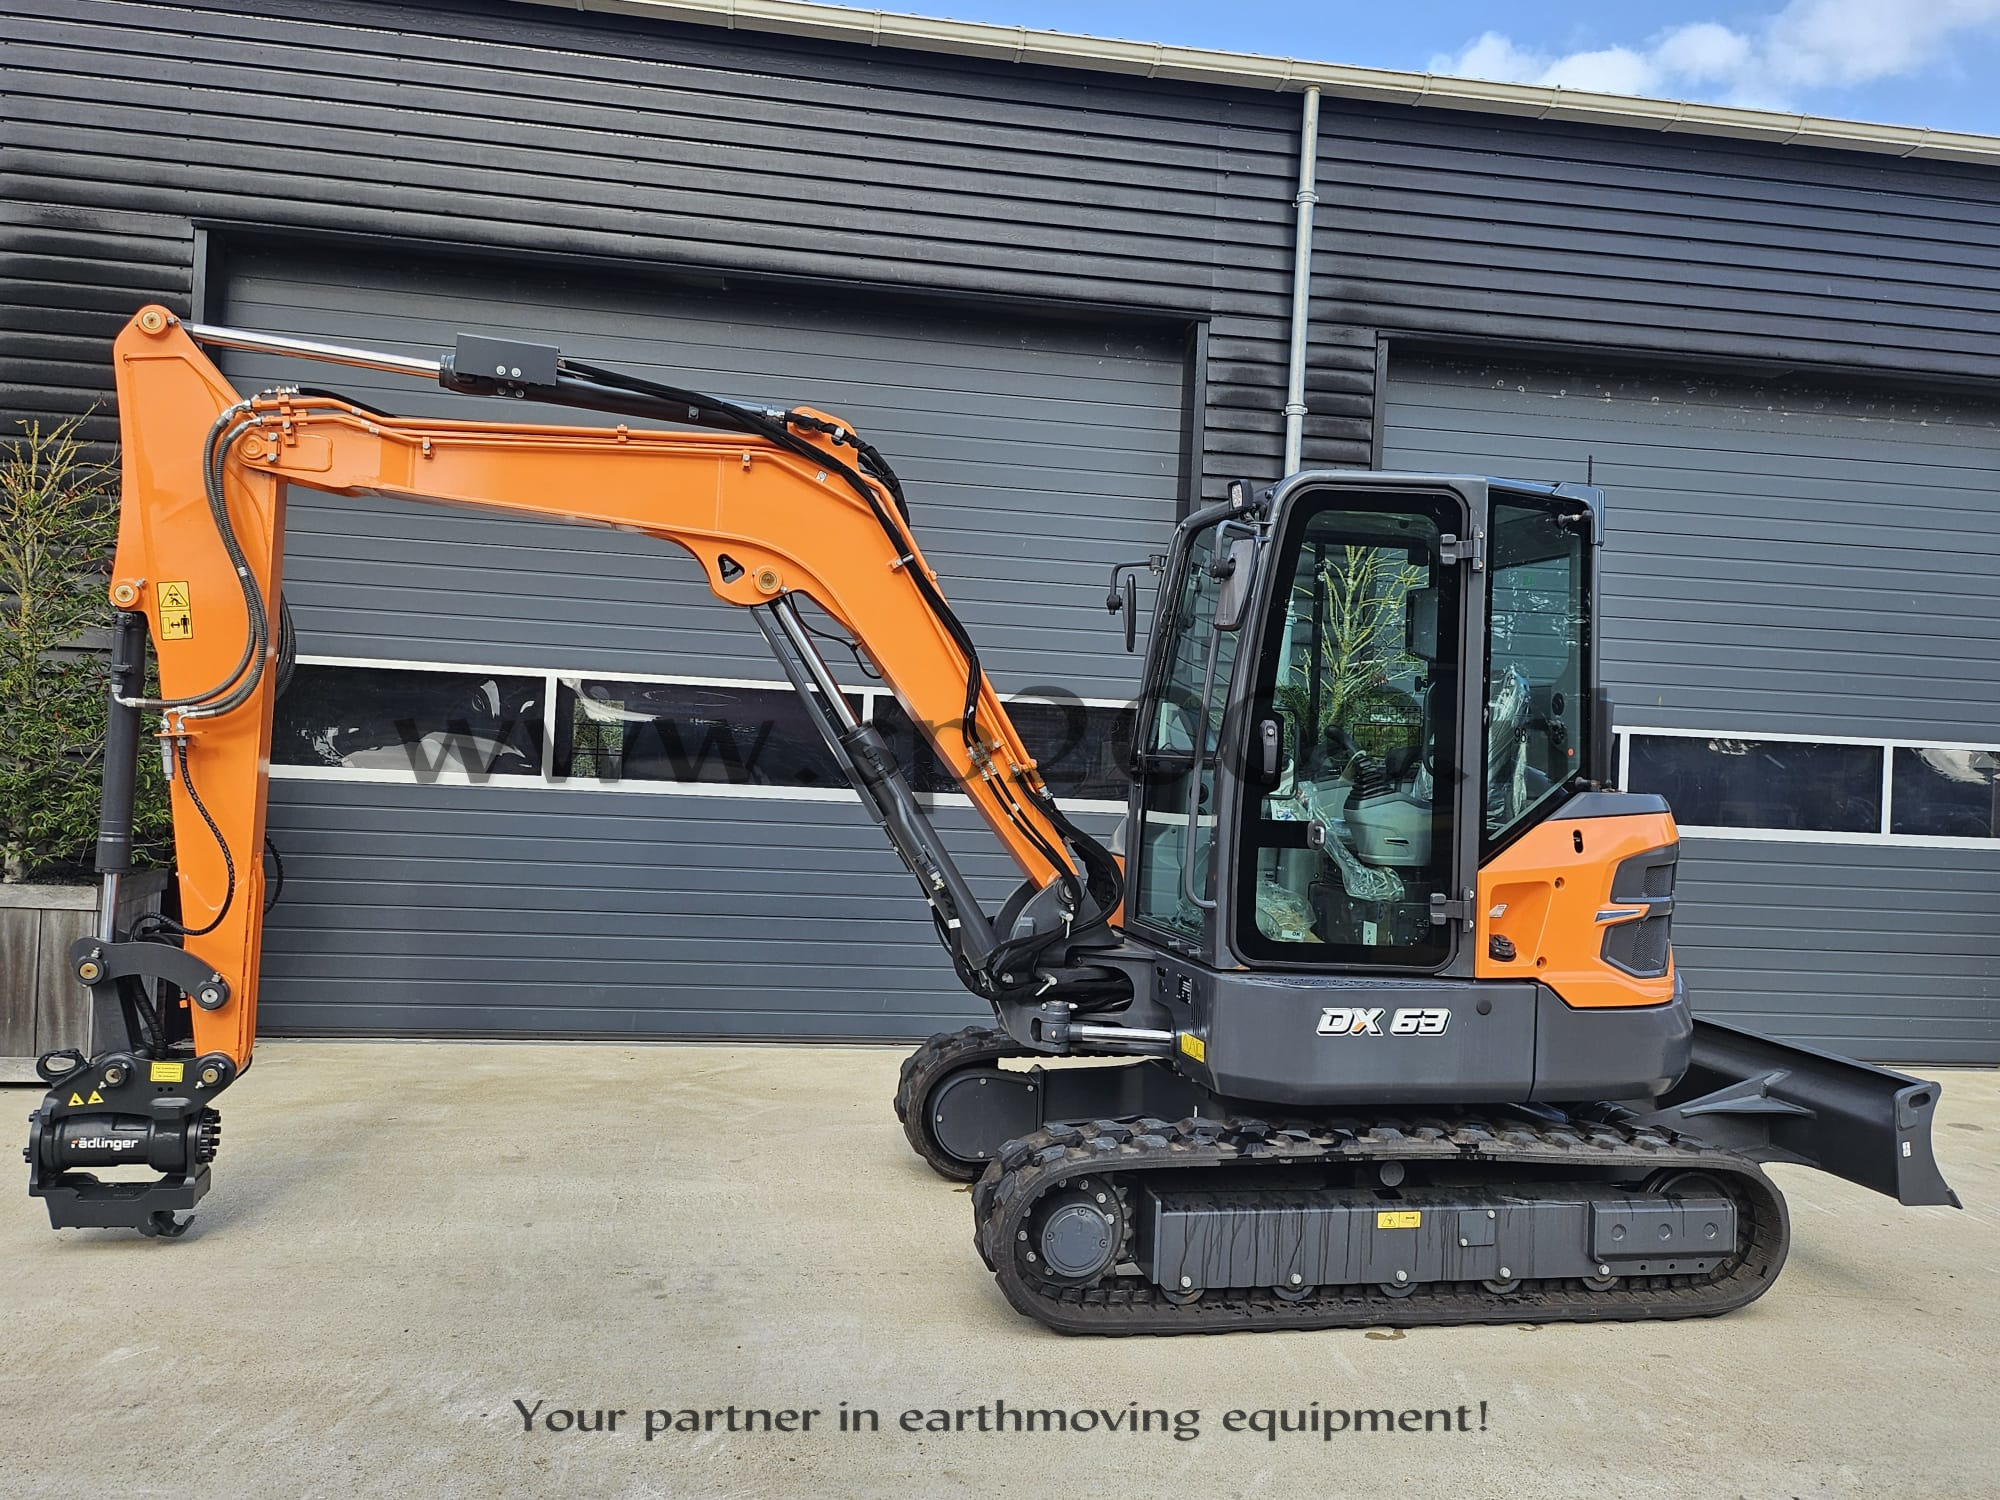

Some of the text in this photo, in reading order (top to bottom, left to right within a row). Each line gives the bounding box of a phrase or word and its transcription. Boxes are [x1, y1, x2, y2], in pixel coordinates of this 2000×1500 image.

[1514, 727, 1527, 743] 98
[1316, 1007, 1452, 1037] DX 63
[70, 1137, 139, 1151] rädlinger
